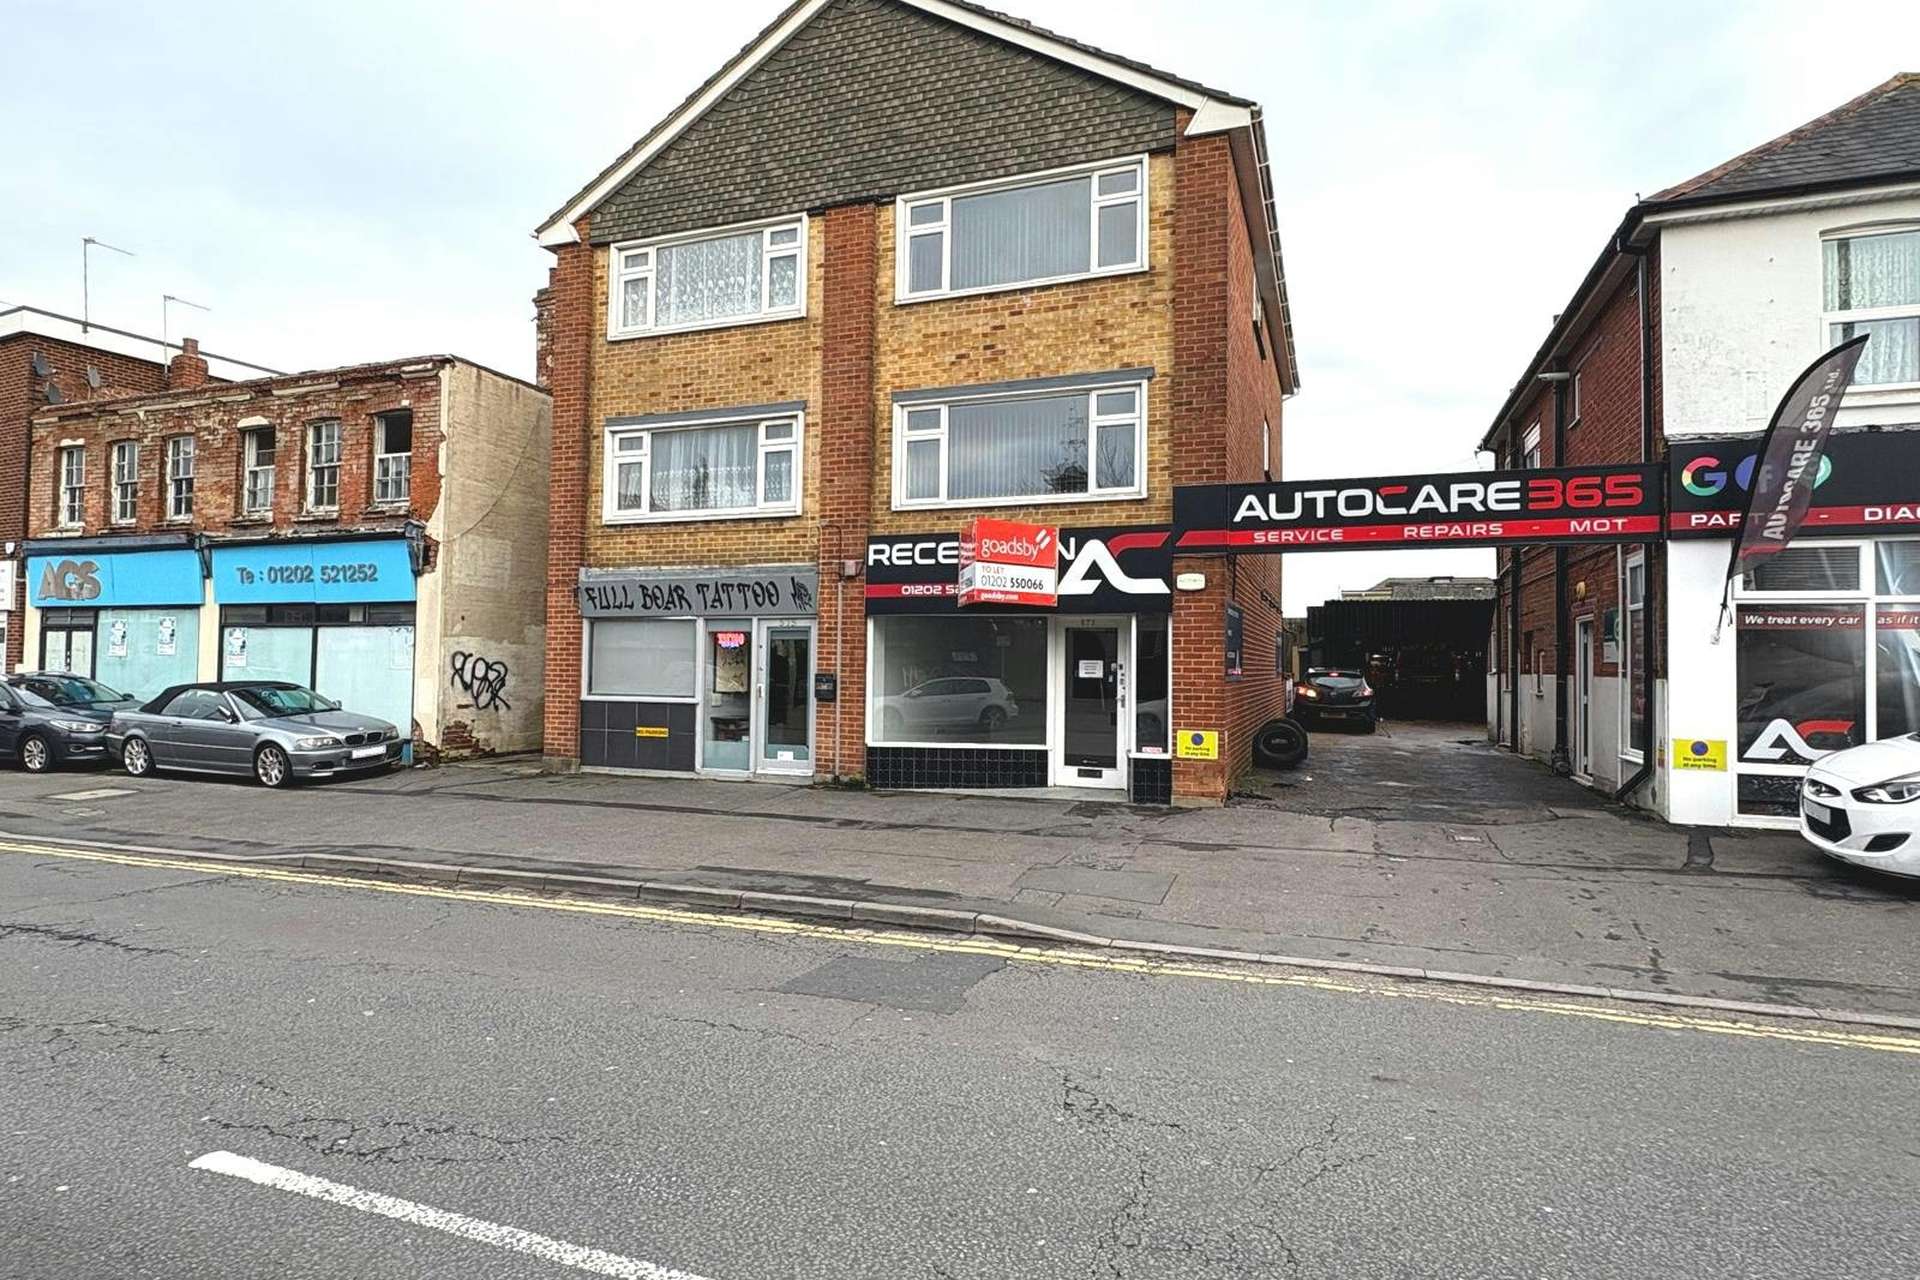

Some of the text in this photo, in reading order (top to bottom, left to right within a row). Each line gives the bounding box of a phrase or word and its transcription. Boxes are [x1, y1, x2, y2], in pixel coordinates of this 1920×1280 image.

[1801, 395, 1830, 433] 365
[1864, 506, 1920, 521] DIA
[1253, 529, 1344, 543] SERVICE
[1404, 523, 1503, 538] REPAIRS
[1570, 519, 1629, 533] MOT
[981, 536, 1040, 562] goadsby
[267, 565, 314, 584] 01202
[320, 563, 378, 584] 521252
[982, 565, 1005, 574] TO LET
[901, 585, 942, 595] 01202
[981, 575, 1007, 588] 01202
[1010, 577, 1044, 590] 550066
[585, 580, 780, 612] FULL BOAR TATTOO
[1744, 614, 1920, 627] We treat every car as if it
